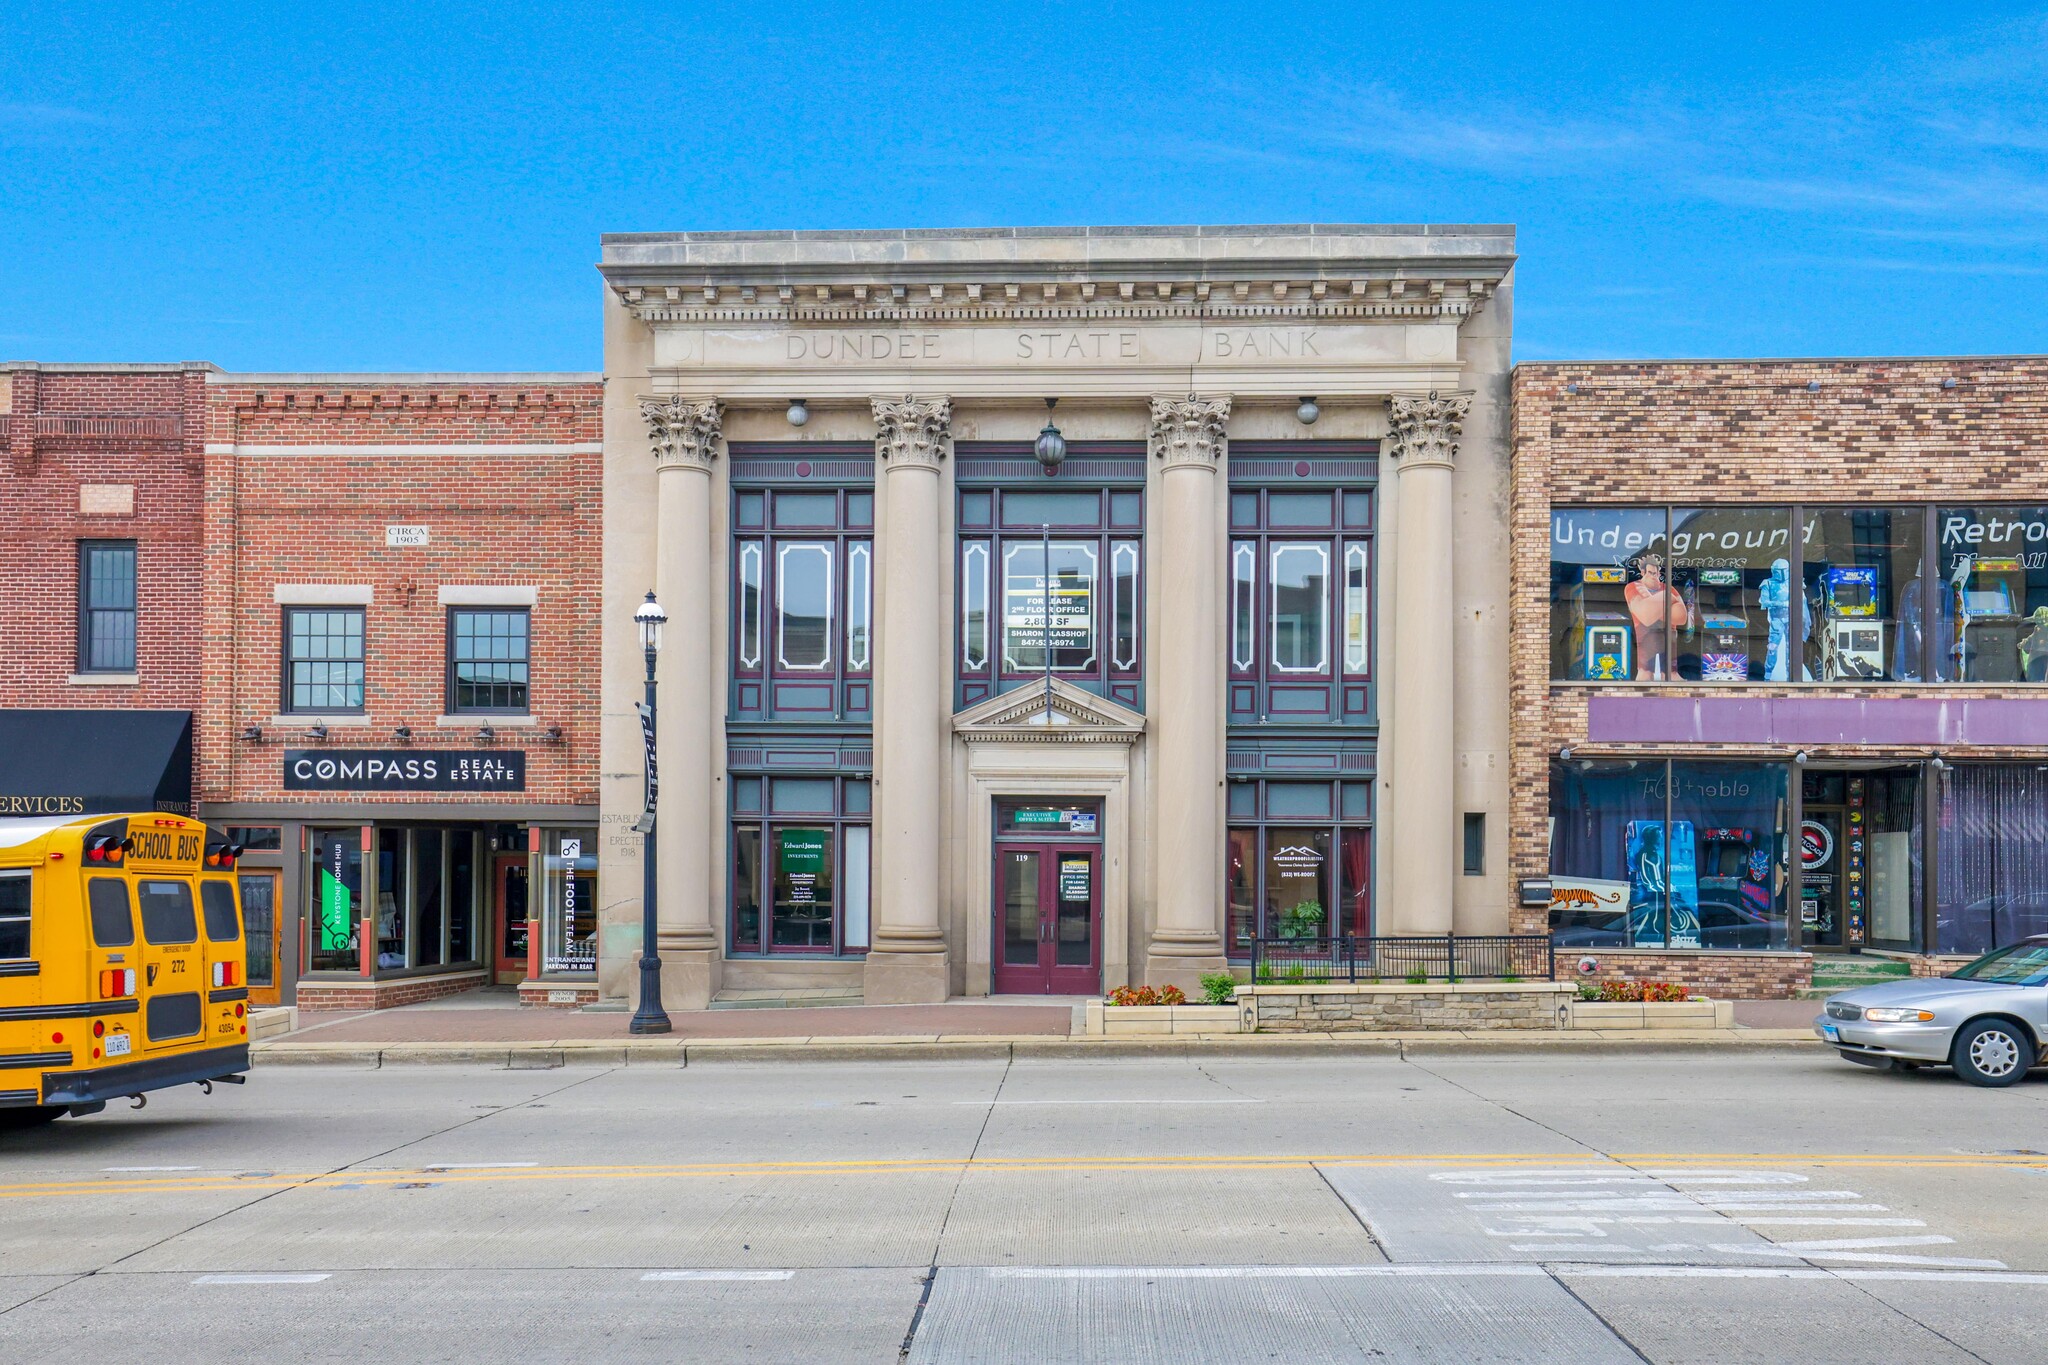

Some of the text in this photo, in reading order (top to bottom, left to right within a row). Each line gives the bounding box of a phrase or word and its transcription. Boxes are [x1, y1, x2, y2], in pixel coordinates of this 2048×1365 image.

[786, 331, 1321, 361] DUNDEE STATE BANK
[388, 527, 425, 535] CIRCA
[395, 536, 419, 544] 1905
[1555, 517, 1815, 556] Underground
[1643, 554, 1748, 569] uarters
[1027, 597, 1072, 605] FOR EASE
[1024, 617, 1070, 626] 2,800 SF
[460, 759, 505, 769] REAL
[294, 759, 438, 780] COMPASS
[450, 769, 514, 780] ESTATE
[156, 800, 189, 812] INSURANCE
[601, 814, 641, 823] ESTABLIS
[128, 831, 200, 862] SCHOOL BUS
[620, 847, 636, 857] 1918
[1015, 854, 1028, 862] 119
[334, 885, 342, 925] KEYSTONE
[565, 860, 575, 953] THE FOOTE TEAM
[1670, 934, 1697, 944] starz
[171, 959, 186, 974] 272
[218, 1023, 235, 1033] 43054
